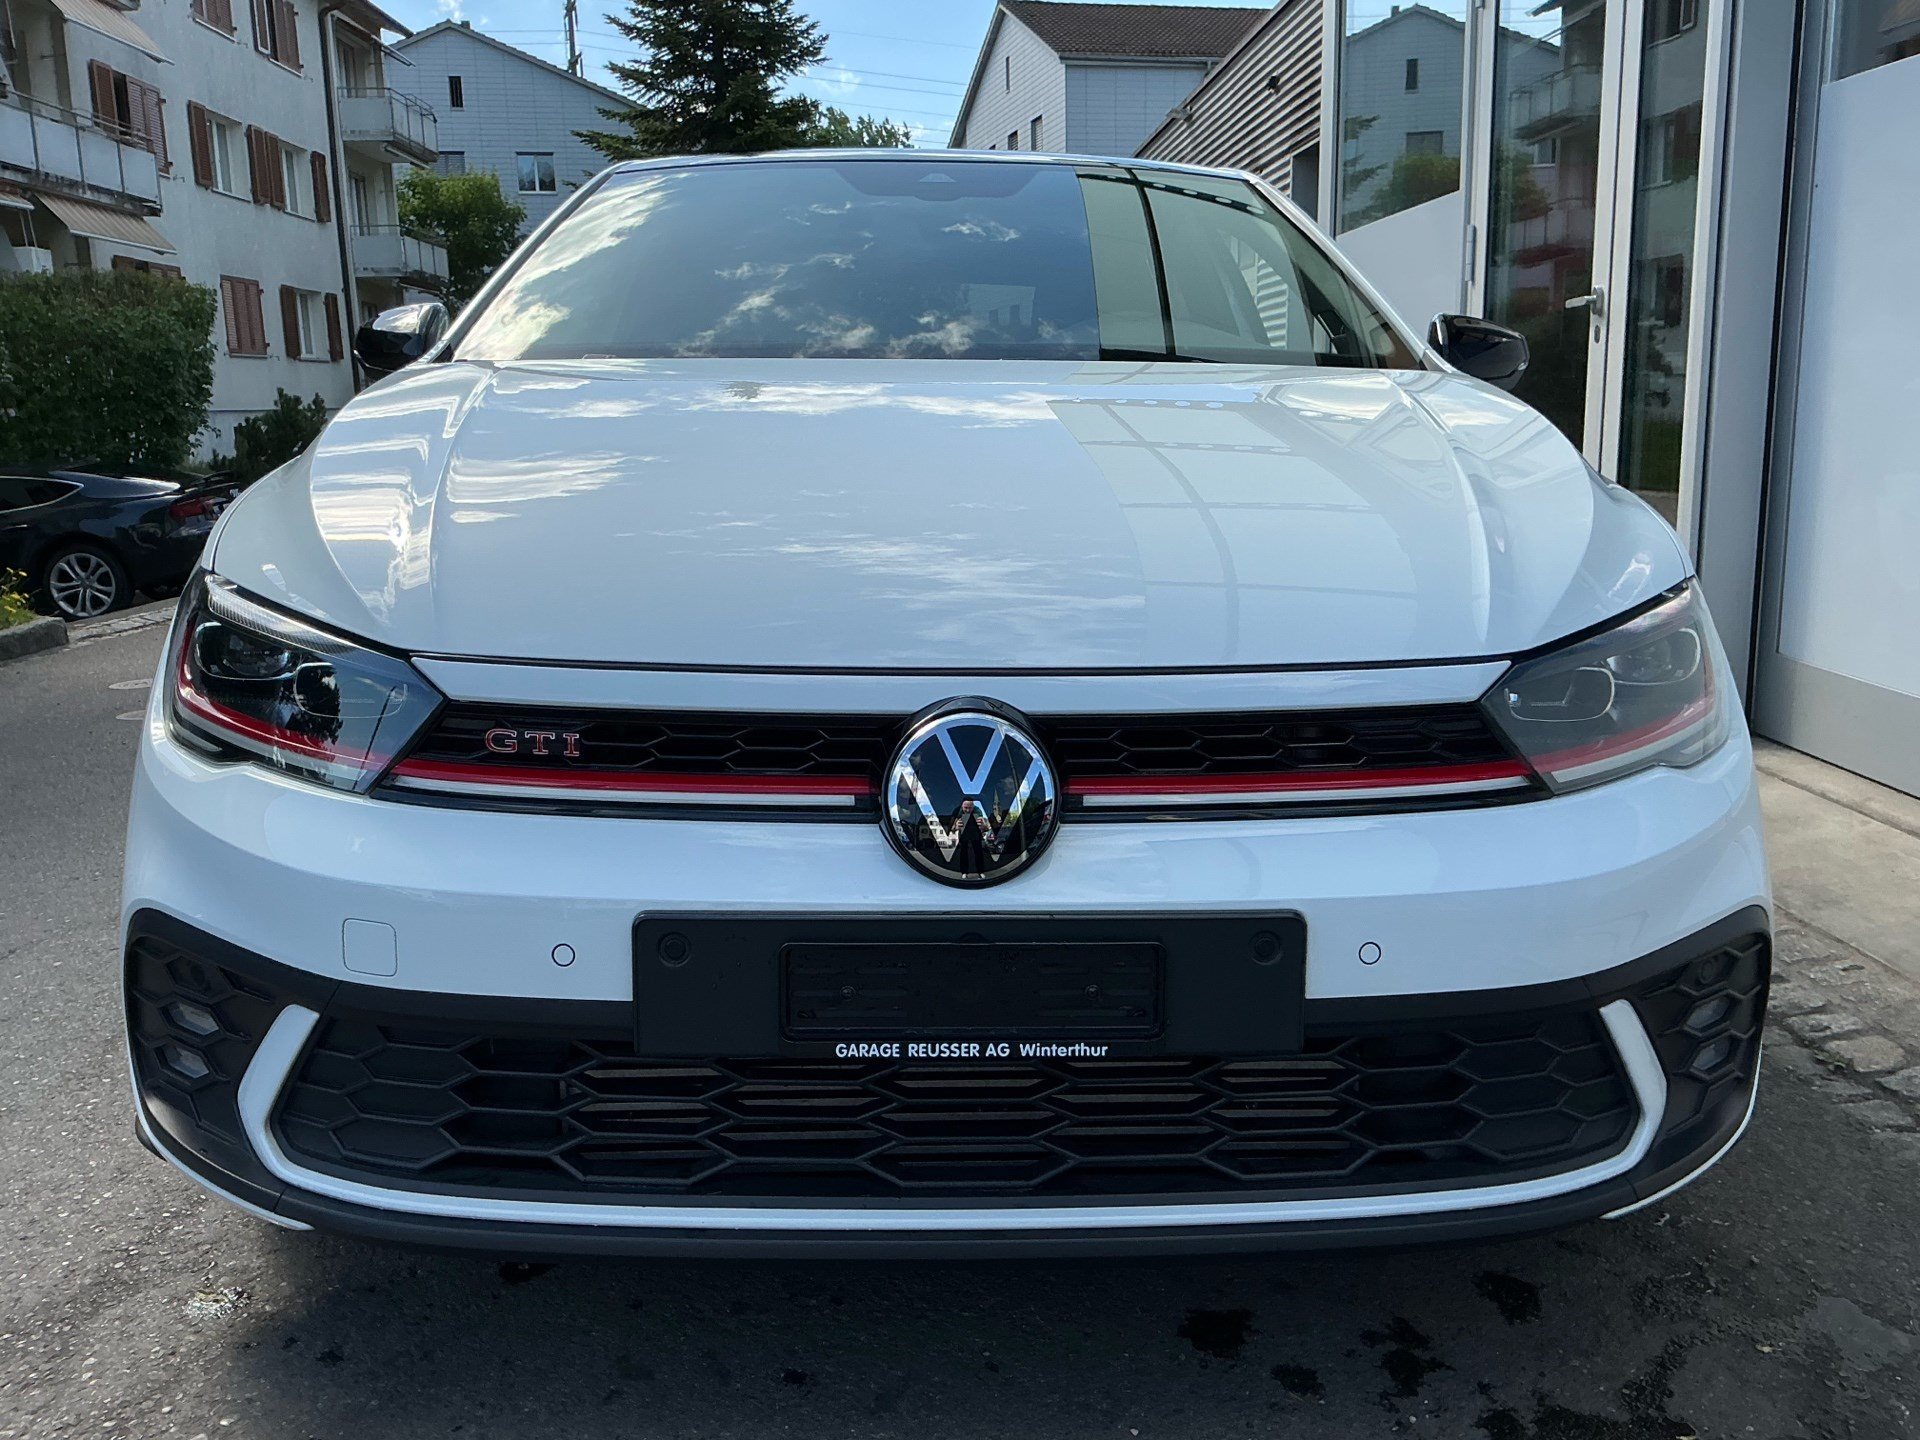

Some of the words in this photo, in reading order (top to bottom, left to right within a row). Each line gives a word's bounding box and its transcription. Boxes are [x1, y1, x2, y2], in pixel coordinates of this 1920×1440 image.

[485, 728, 580, 757] GTI
[835, 1043, 900, 1058] GARAGE
[908, 1043, 980, 1058] REUSSER
[985, 1043, 1011, 1058] AG
[1019, 1042, 1109, 1058] Winterthur
